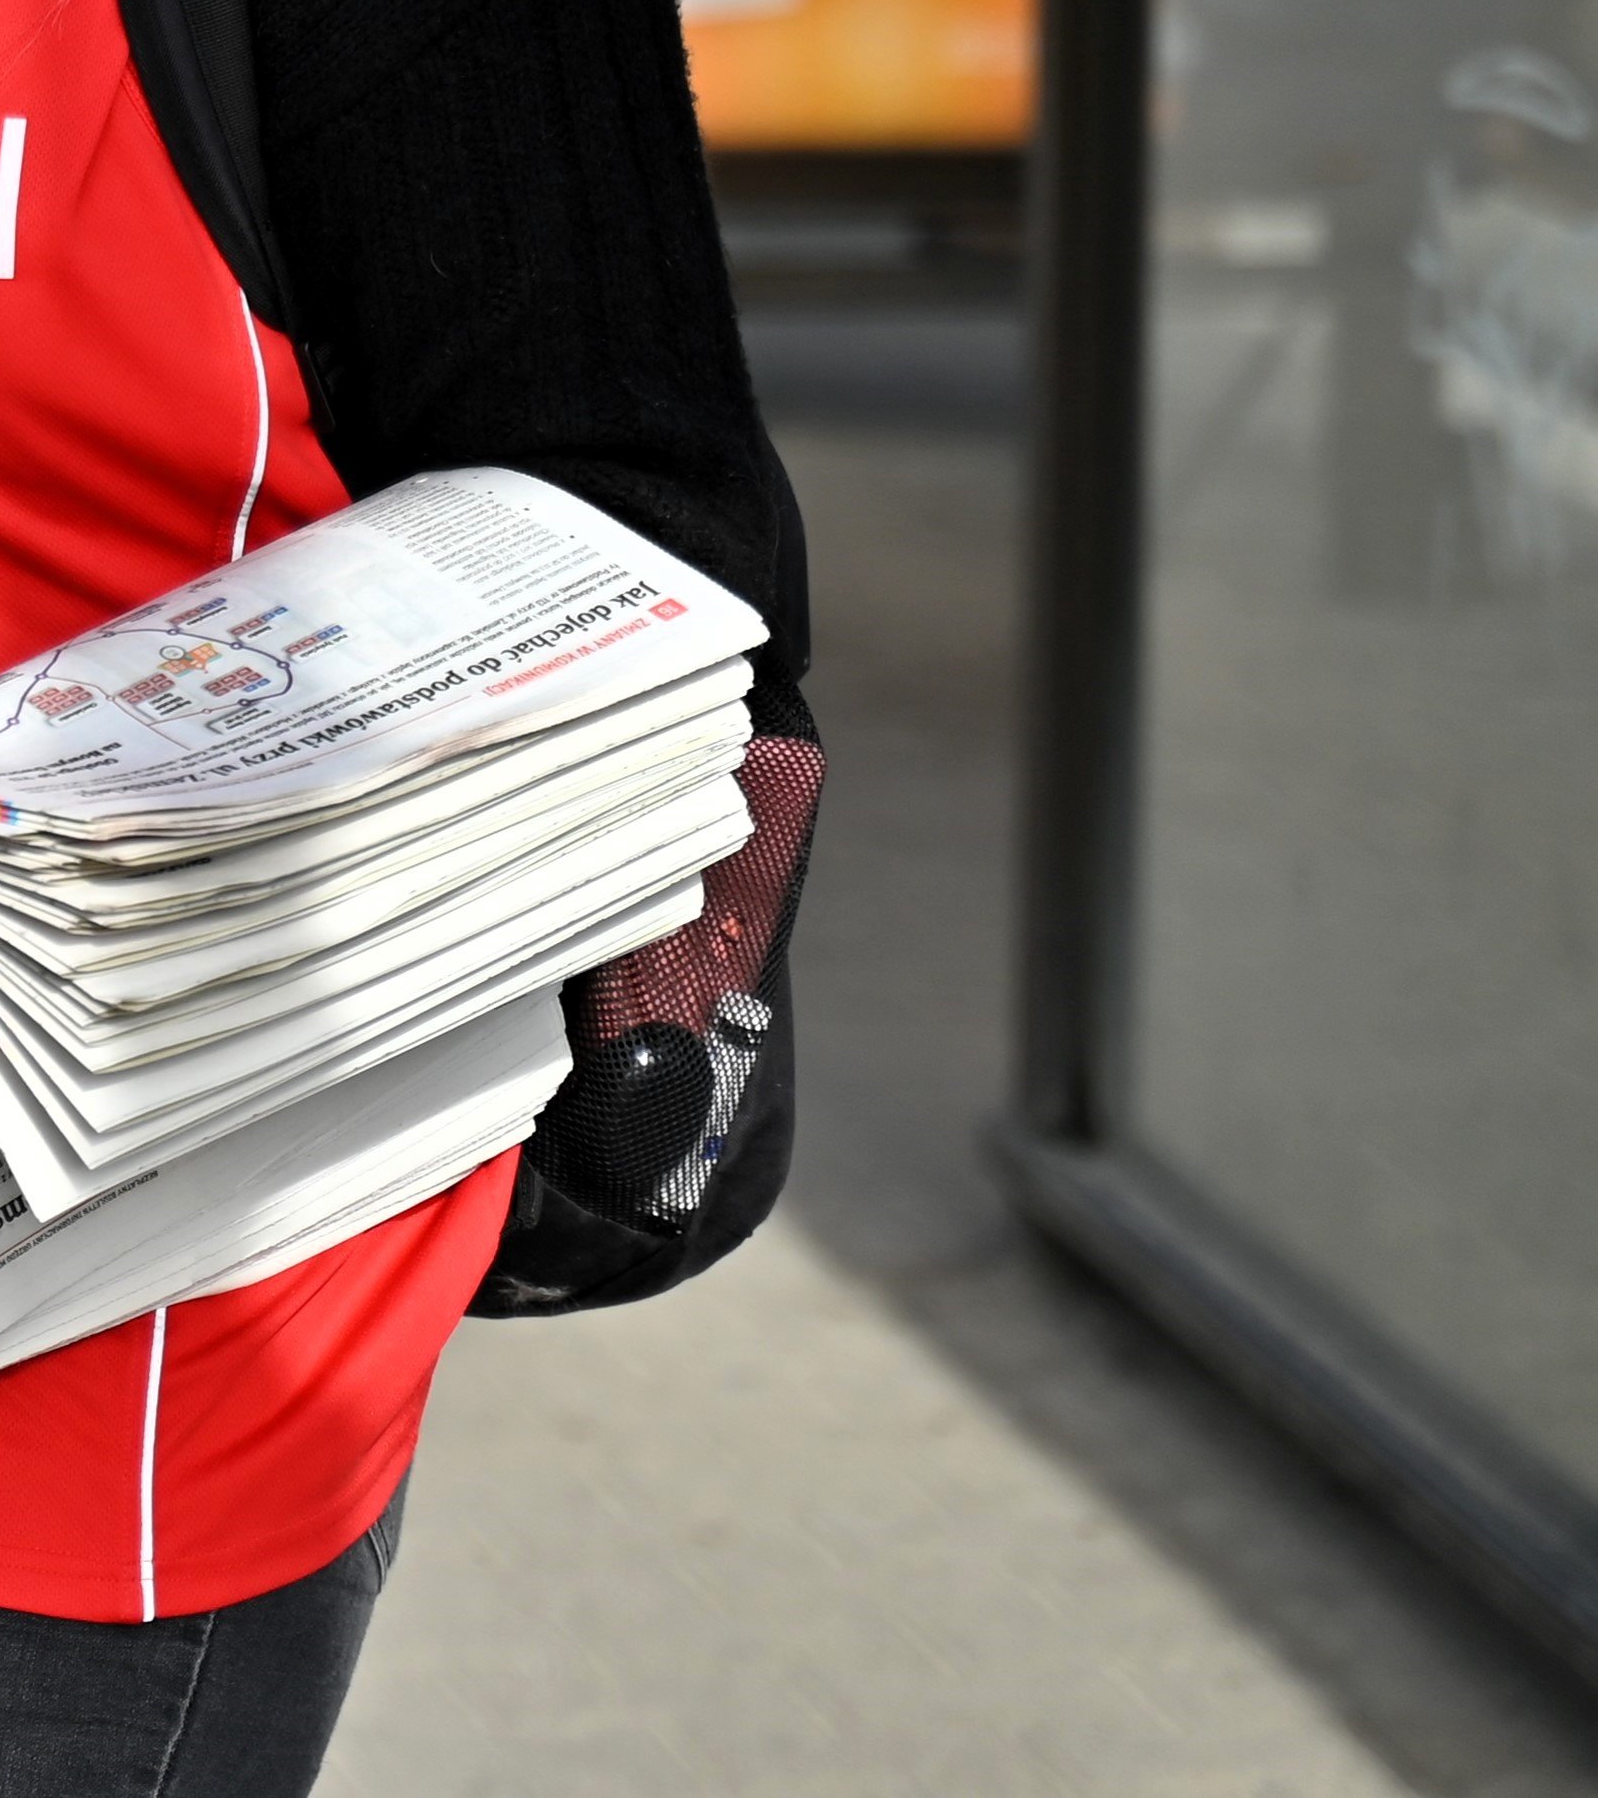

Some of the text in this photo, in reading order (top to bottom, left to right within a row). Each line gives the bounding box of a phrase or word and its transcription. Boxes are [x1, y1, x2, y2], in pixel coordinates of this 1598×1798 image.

[609, 580, 660, 607] Jak
[655, 603, 681, 617] 16
[500, 604, 611, 662] dojechać
[466, 657, 501, 675] do
[482, 617, 650, 696] ZMIANY W KOMUNIKACJI
[296, 669, 467, 748] podstawówki
[239, 740, 300, 766] przy
[201, 764, 239, 776] ul.
[117, 1169, 158, 1195] BEZPŁATNY
[32, 1210, 83, 1246] INFORMACYJNY
